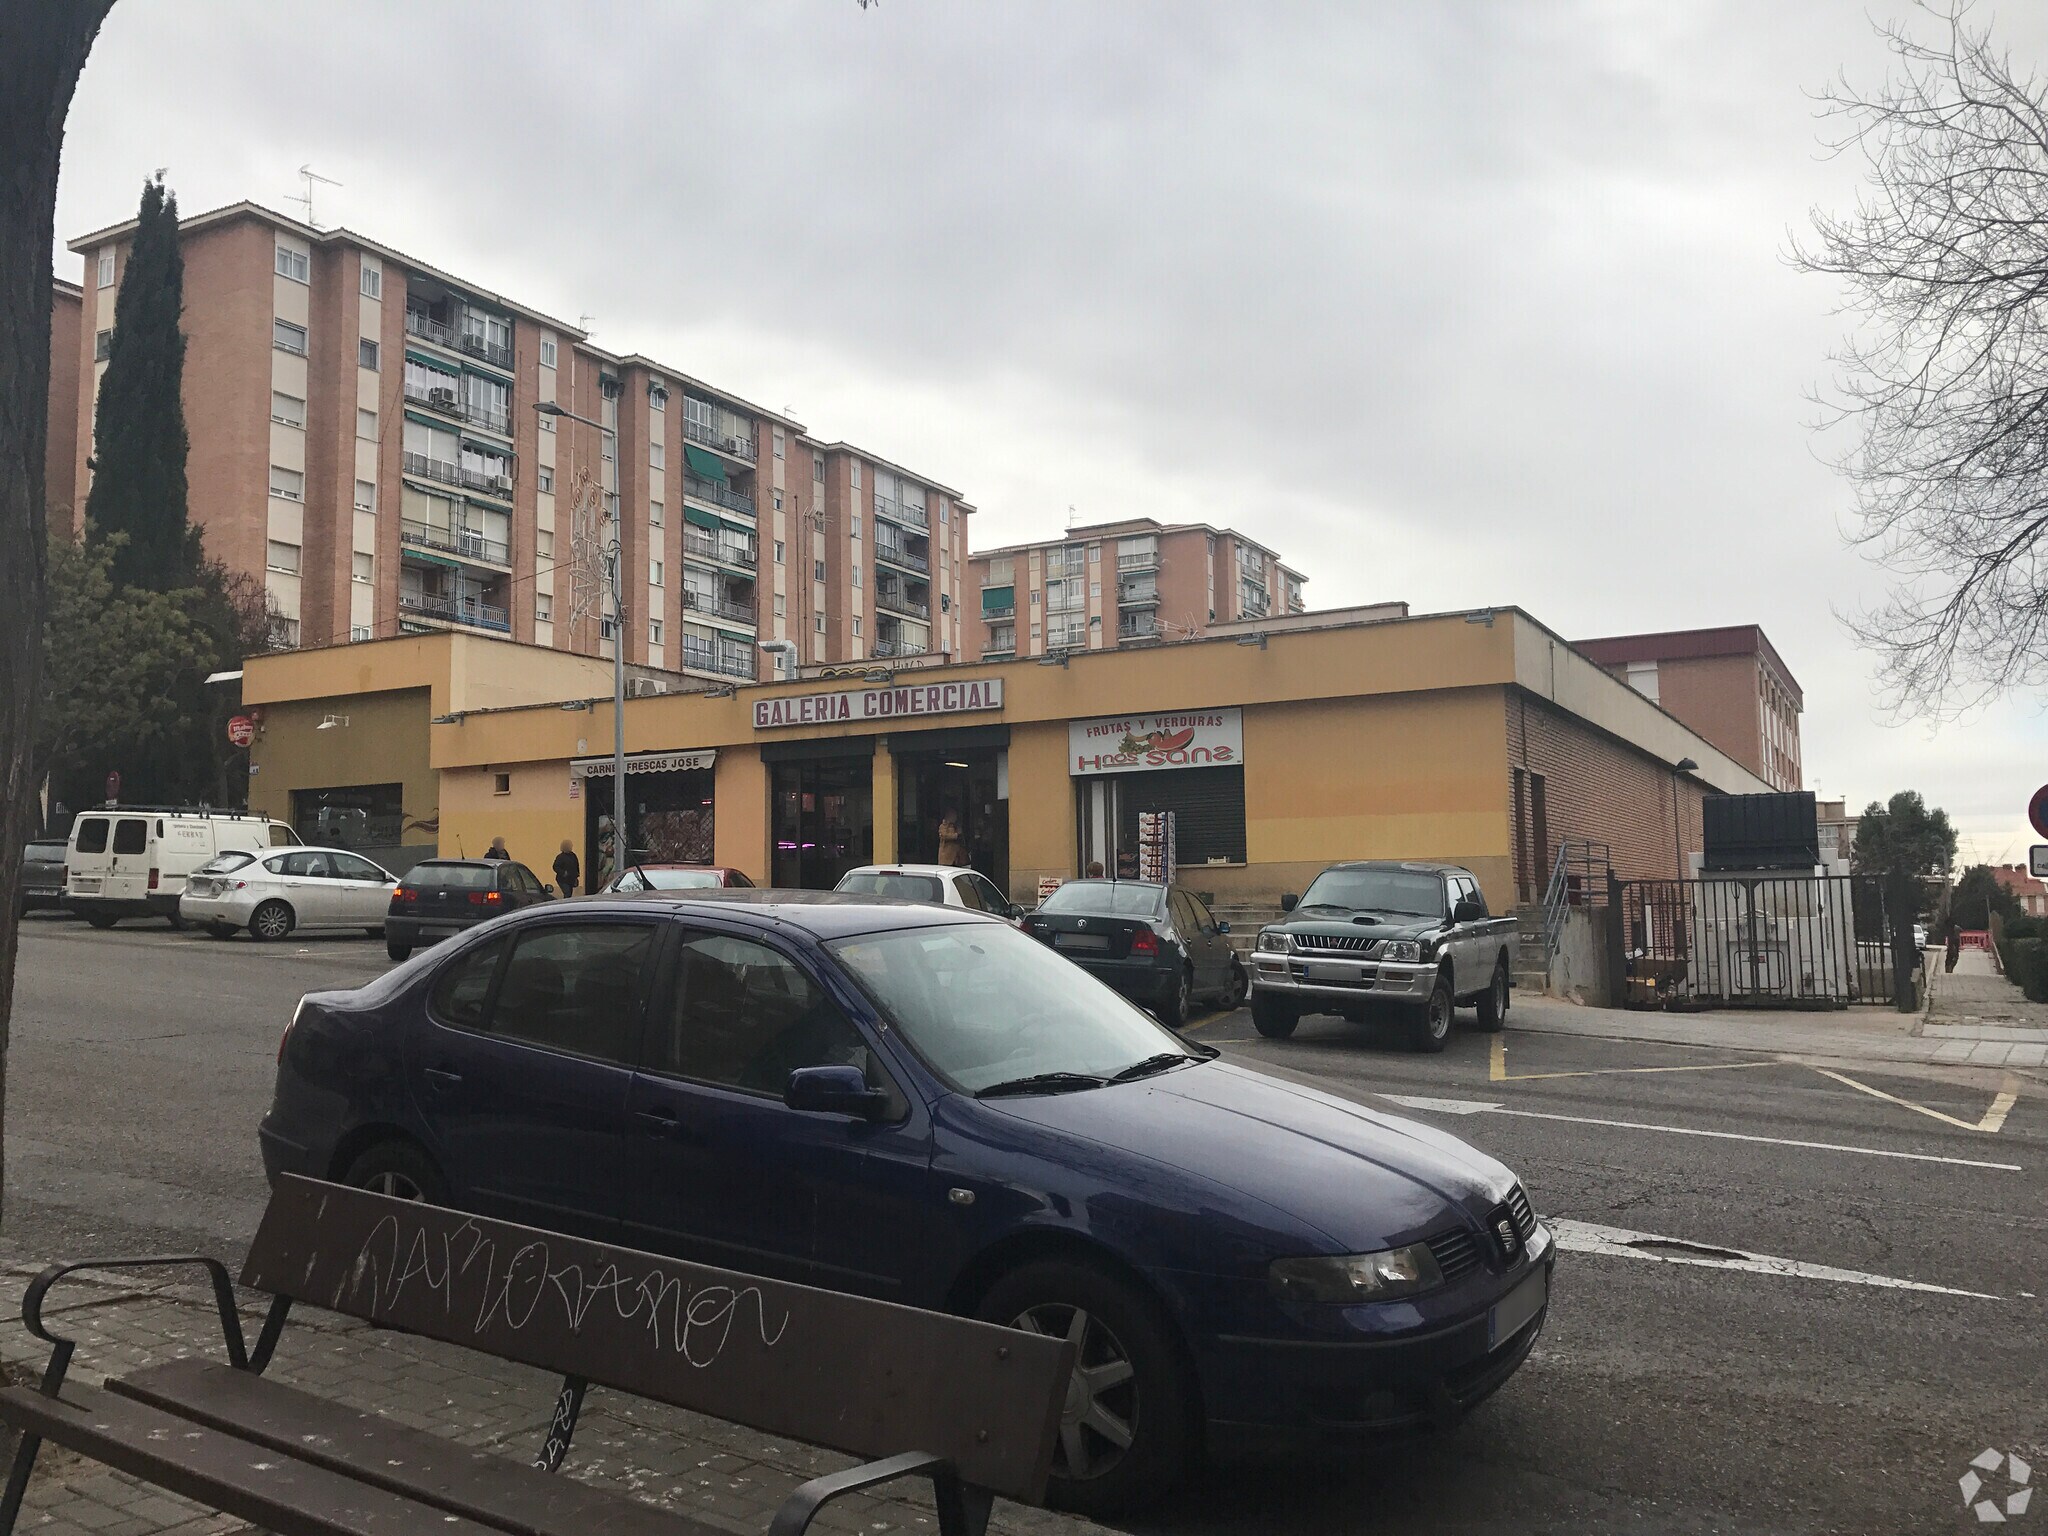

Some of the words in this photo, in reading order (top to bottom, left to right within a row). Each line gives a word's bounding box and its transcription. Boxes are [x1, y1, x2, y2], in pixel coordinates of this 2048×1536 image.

[756, 695, 850, 726] GALERIA
[863, 682, 999, 717] COMERCIAL
[1086, 721, 1131, 738] FRUTAS
[1138, 719, 1146, 730] Y
[1155, 716, 1224, 729] VERDURAS
[587, 764, 616, 775] CARNE
[626, 759, 668, 772] FRESCAS
[671, 757, 699, 768] JOSE
